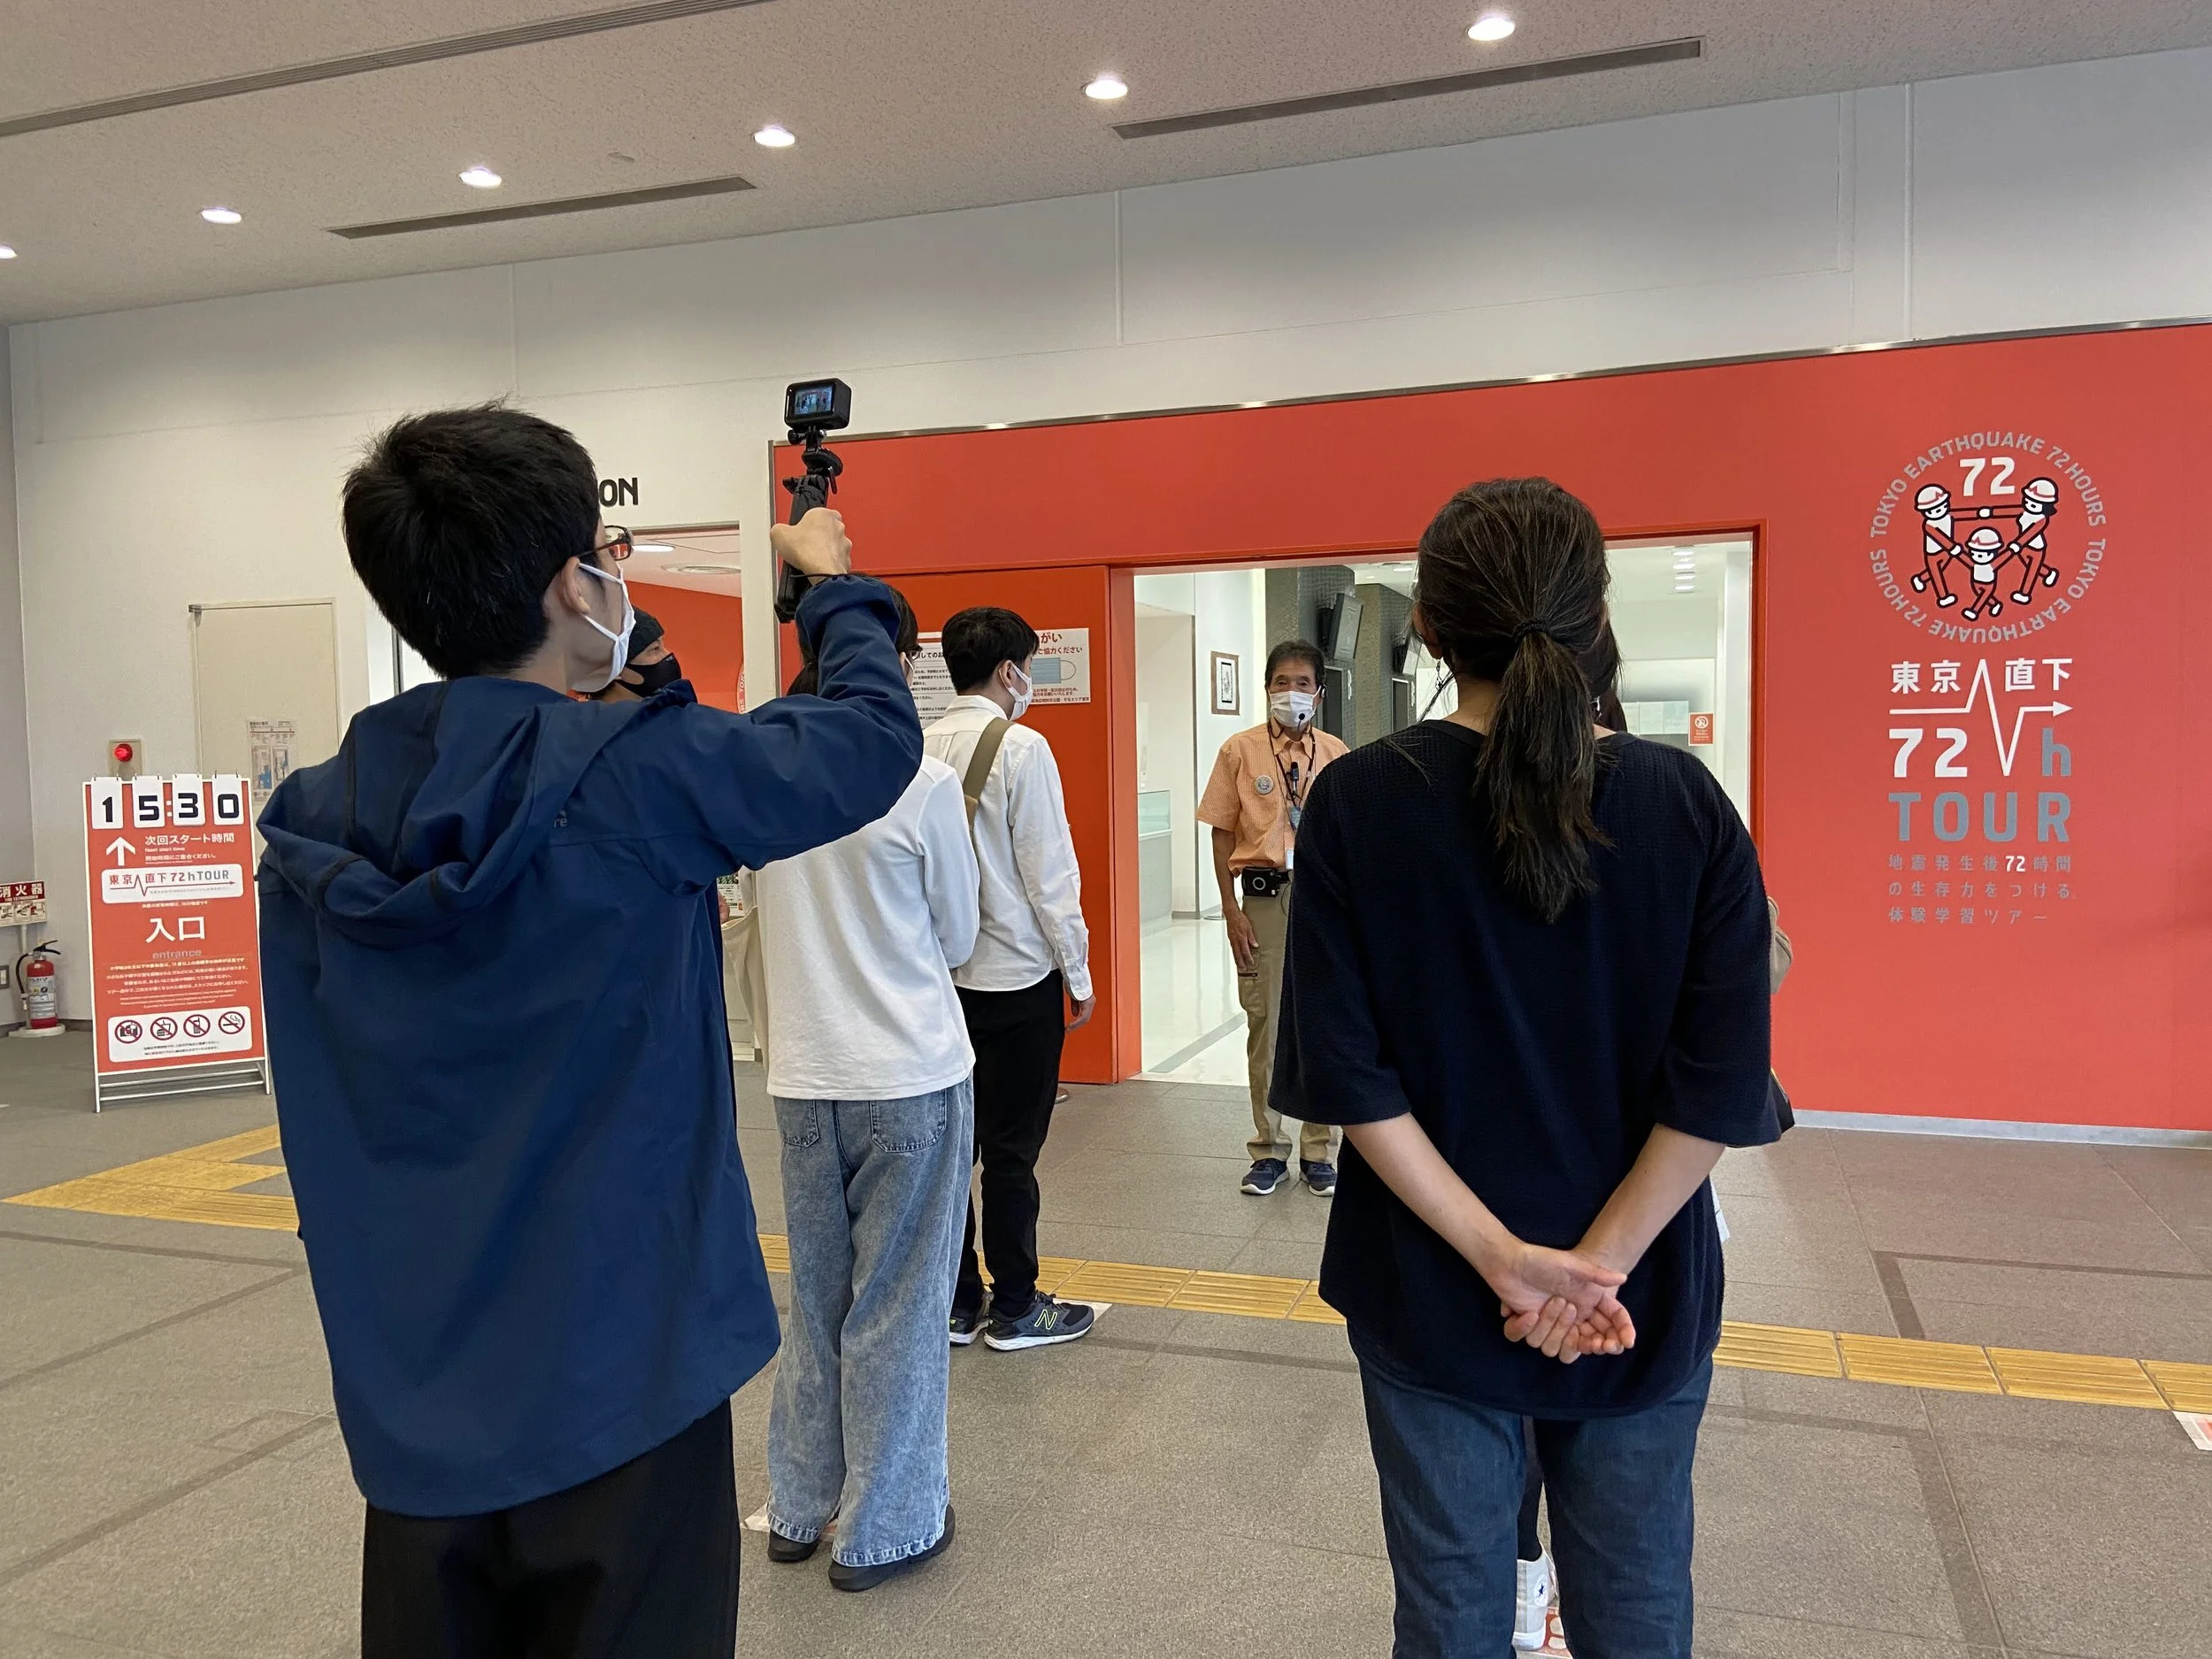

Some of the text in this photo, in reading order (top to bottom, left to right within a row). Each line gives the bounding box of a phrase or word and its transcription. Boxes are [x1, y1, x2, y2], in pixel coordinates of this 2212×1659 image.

[598, 477, 639, 507] ON
[1870, 431, 2107, 538] TOKYO EARTHQUAKE 72 HOURS
[1959, 457, 2016, 496] 72
[1870, 538, 2107, 643] TOKYO EARTHQUAKE 72 HOURS
[1890, 657, 2073, 694] 東京 直下
[1889, 726, 2071, 778] 72 h
[102, 792, 239, 824] 15:30
[1888, 792, 2070, 842] TOUR
[144, 833, 234, 846] 次回スタート時間
[0, 883, 42, 898] 消火器
[109, 874, 134, 885] 東京
[145, 916, 206, 943] 入口
[1888, 906, 2047, 926] 体験学習ツアー
[152, 949, 202, 960] entrance
